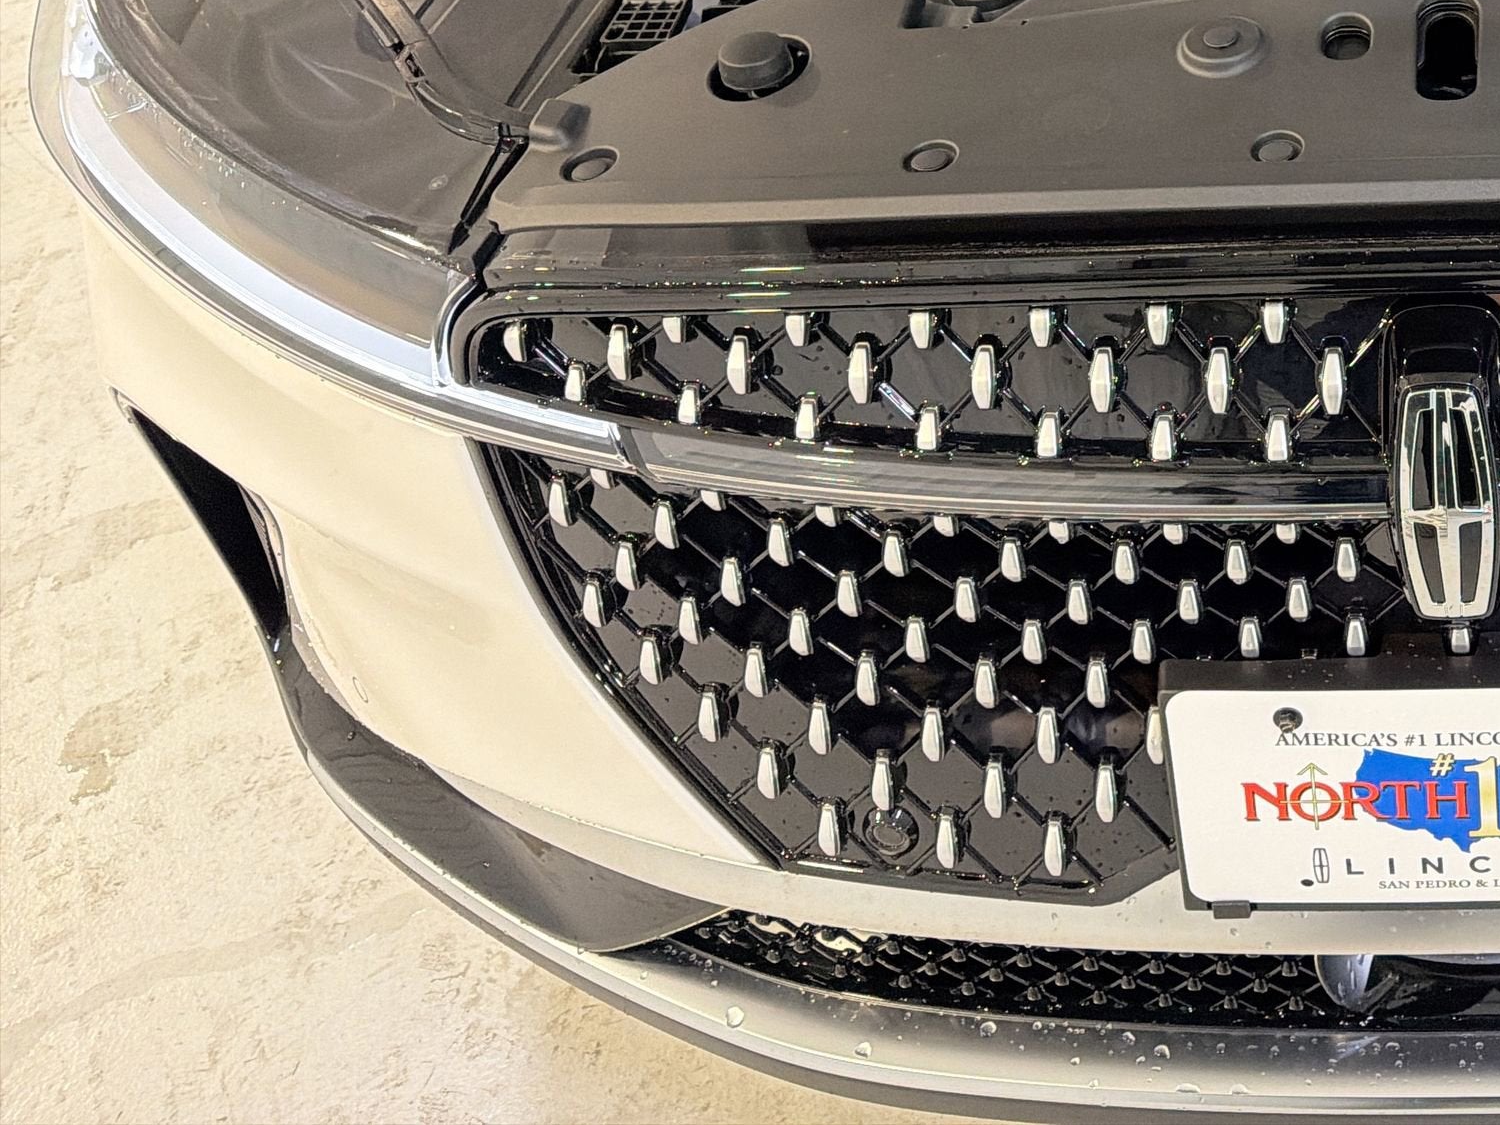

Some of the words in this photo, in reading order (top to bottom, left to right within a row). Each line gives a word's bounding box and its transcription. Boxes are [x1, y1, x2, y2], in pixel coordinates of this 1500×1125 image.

[1275, 731, 1398, 747] AMERICA'S
[1405, 733, 1427, 747] #1
[1241, 781, 1470, 821] NORTH
[1378, 879, 1410, 890] SAN
[1414, 879, 1472, 890] PEDRO
[1475, 878, 1488, 888] &
